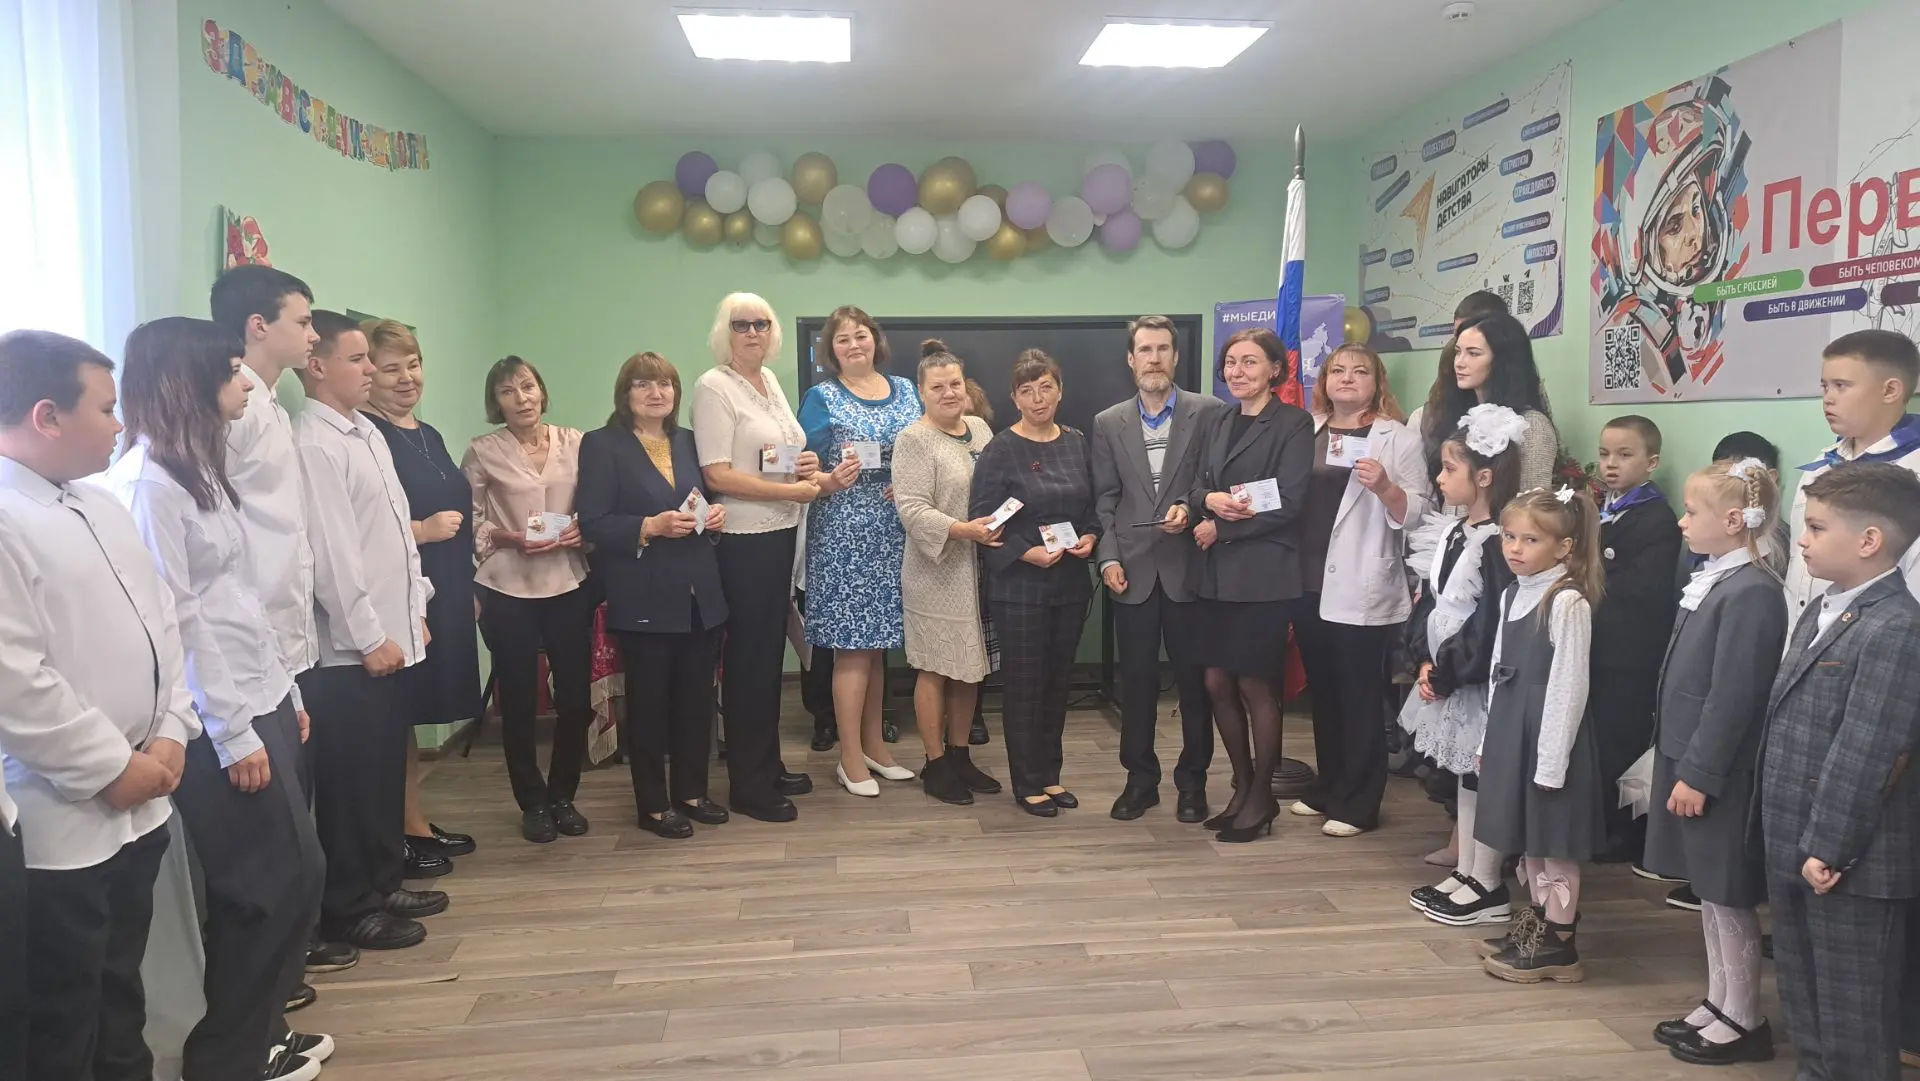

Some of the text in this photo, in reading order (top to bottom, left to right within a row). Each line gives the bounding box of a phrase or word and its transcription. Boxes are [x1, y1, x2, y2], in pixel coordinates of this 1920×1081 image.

[1437, 154, 1489, 209] НАВИГАТОРЫ
[1437, 190, 1472, 233] ДЕТСТВА
[1838, 265, 1864, 279] БЫТЬ
[1716, 277, 1778, 297] БЫТЬ С РОССИЕЙ
[1768, 294, 1846, 314] БЫТЬ В ДВИЖЕНИИ
